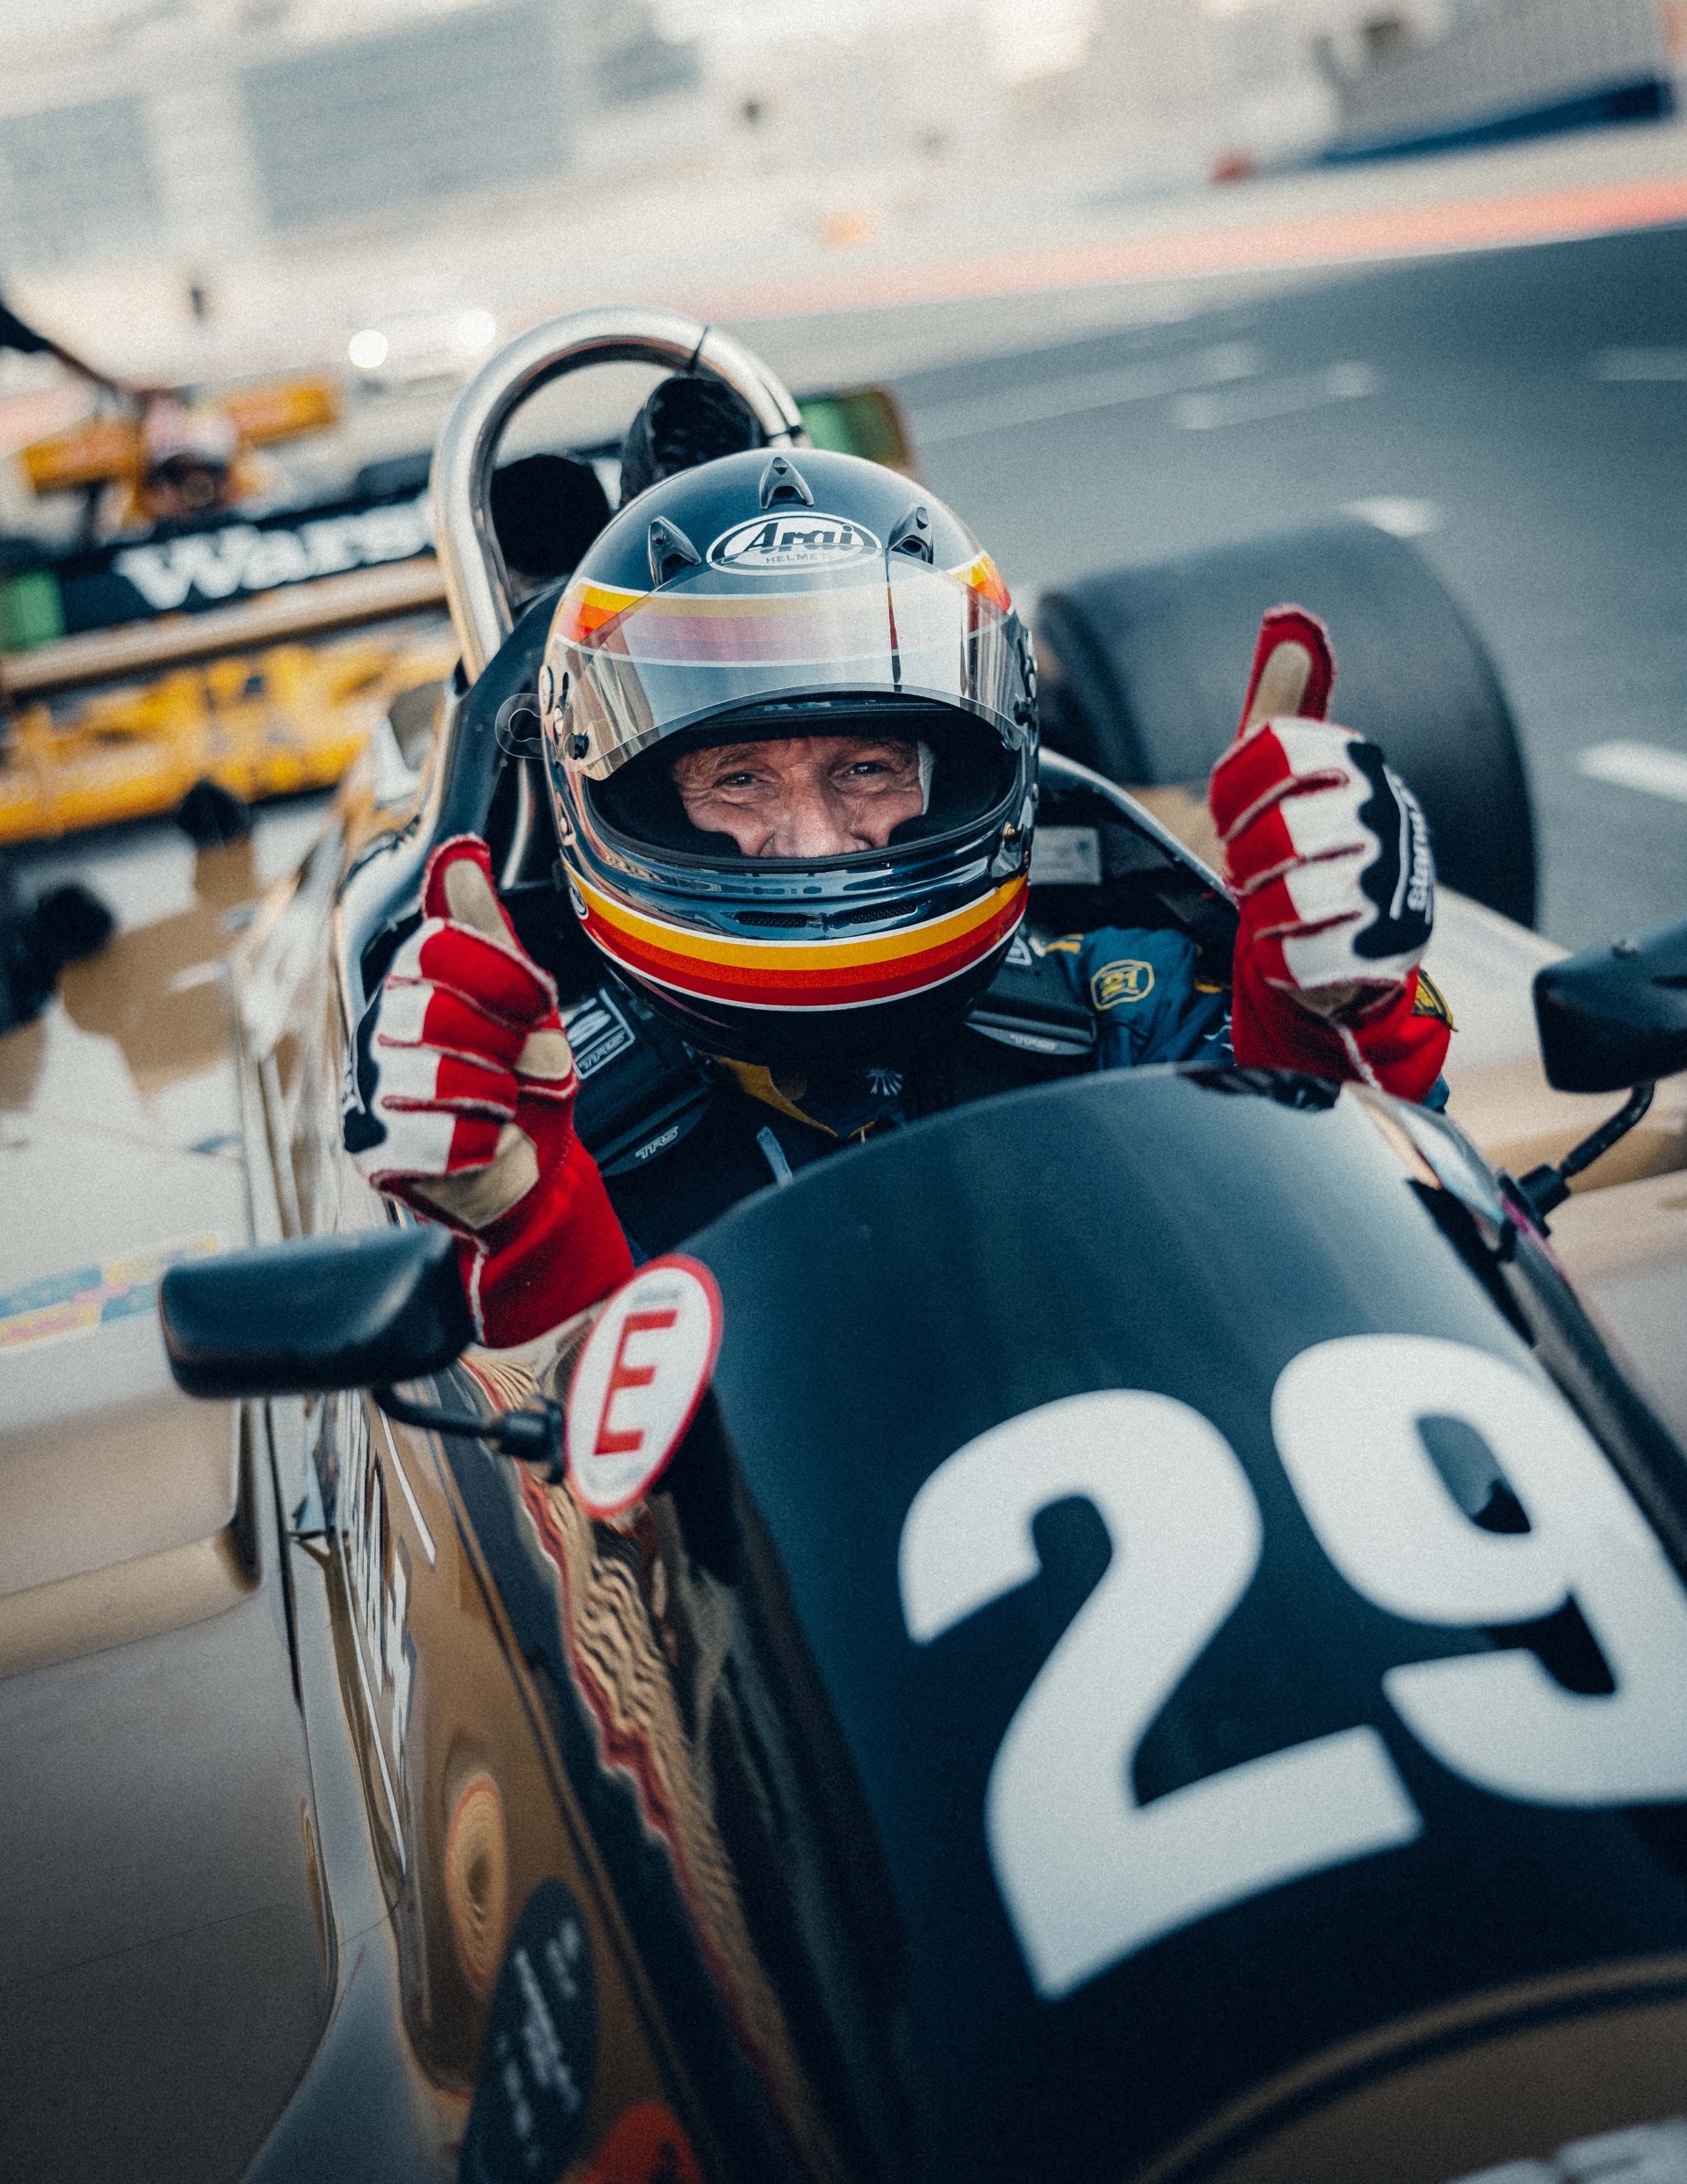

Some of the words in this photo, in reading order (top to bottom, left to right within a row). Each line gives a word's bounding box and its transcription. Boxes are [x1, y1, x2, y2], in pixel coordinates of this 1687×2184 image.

[722, 523, 858, 562] Arai
[765, 552, 829, 564] HELMET
[578, 1029, 626, 1070] TRS
[634, 1125, 680, 1160] TRS
[593, 1308, 680, 1456] E
[898, 1331, 1687, 2002] 29
